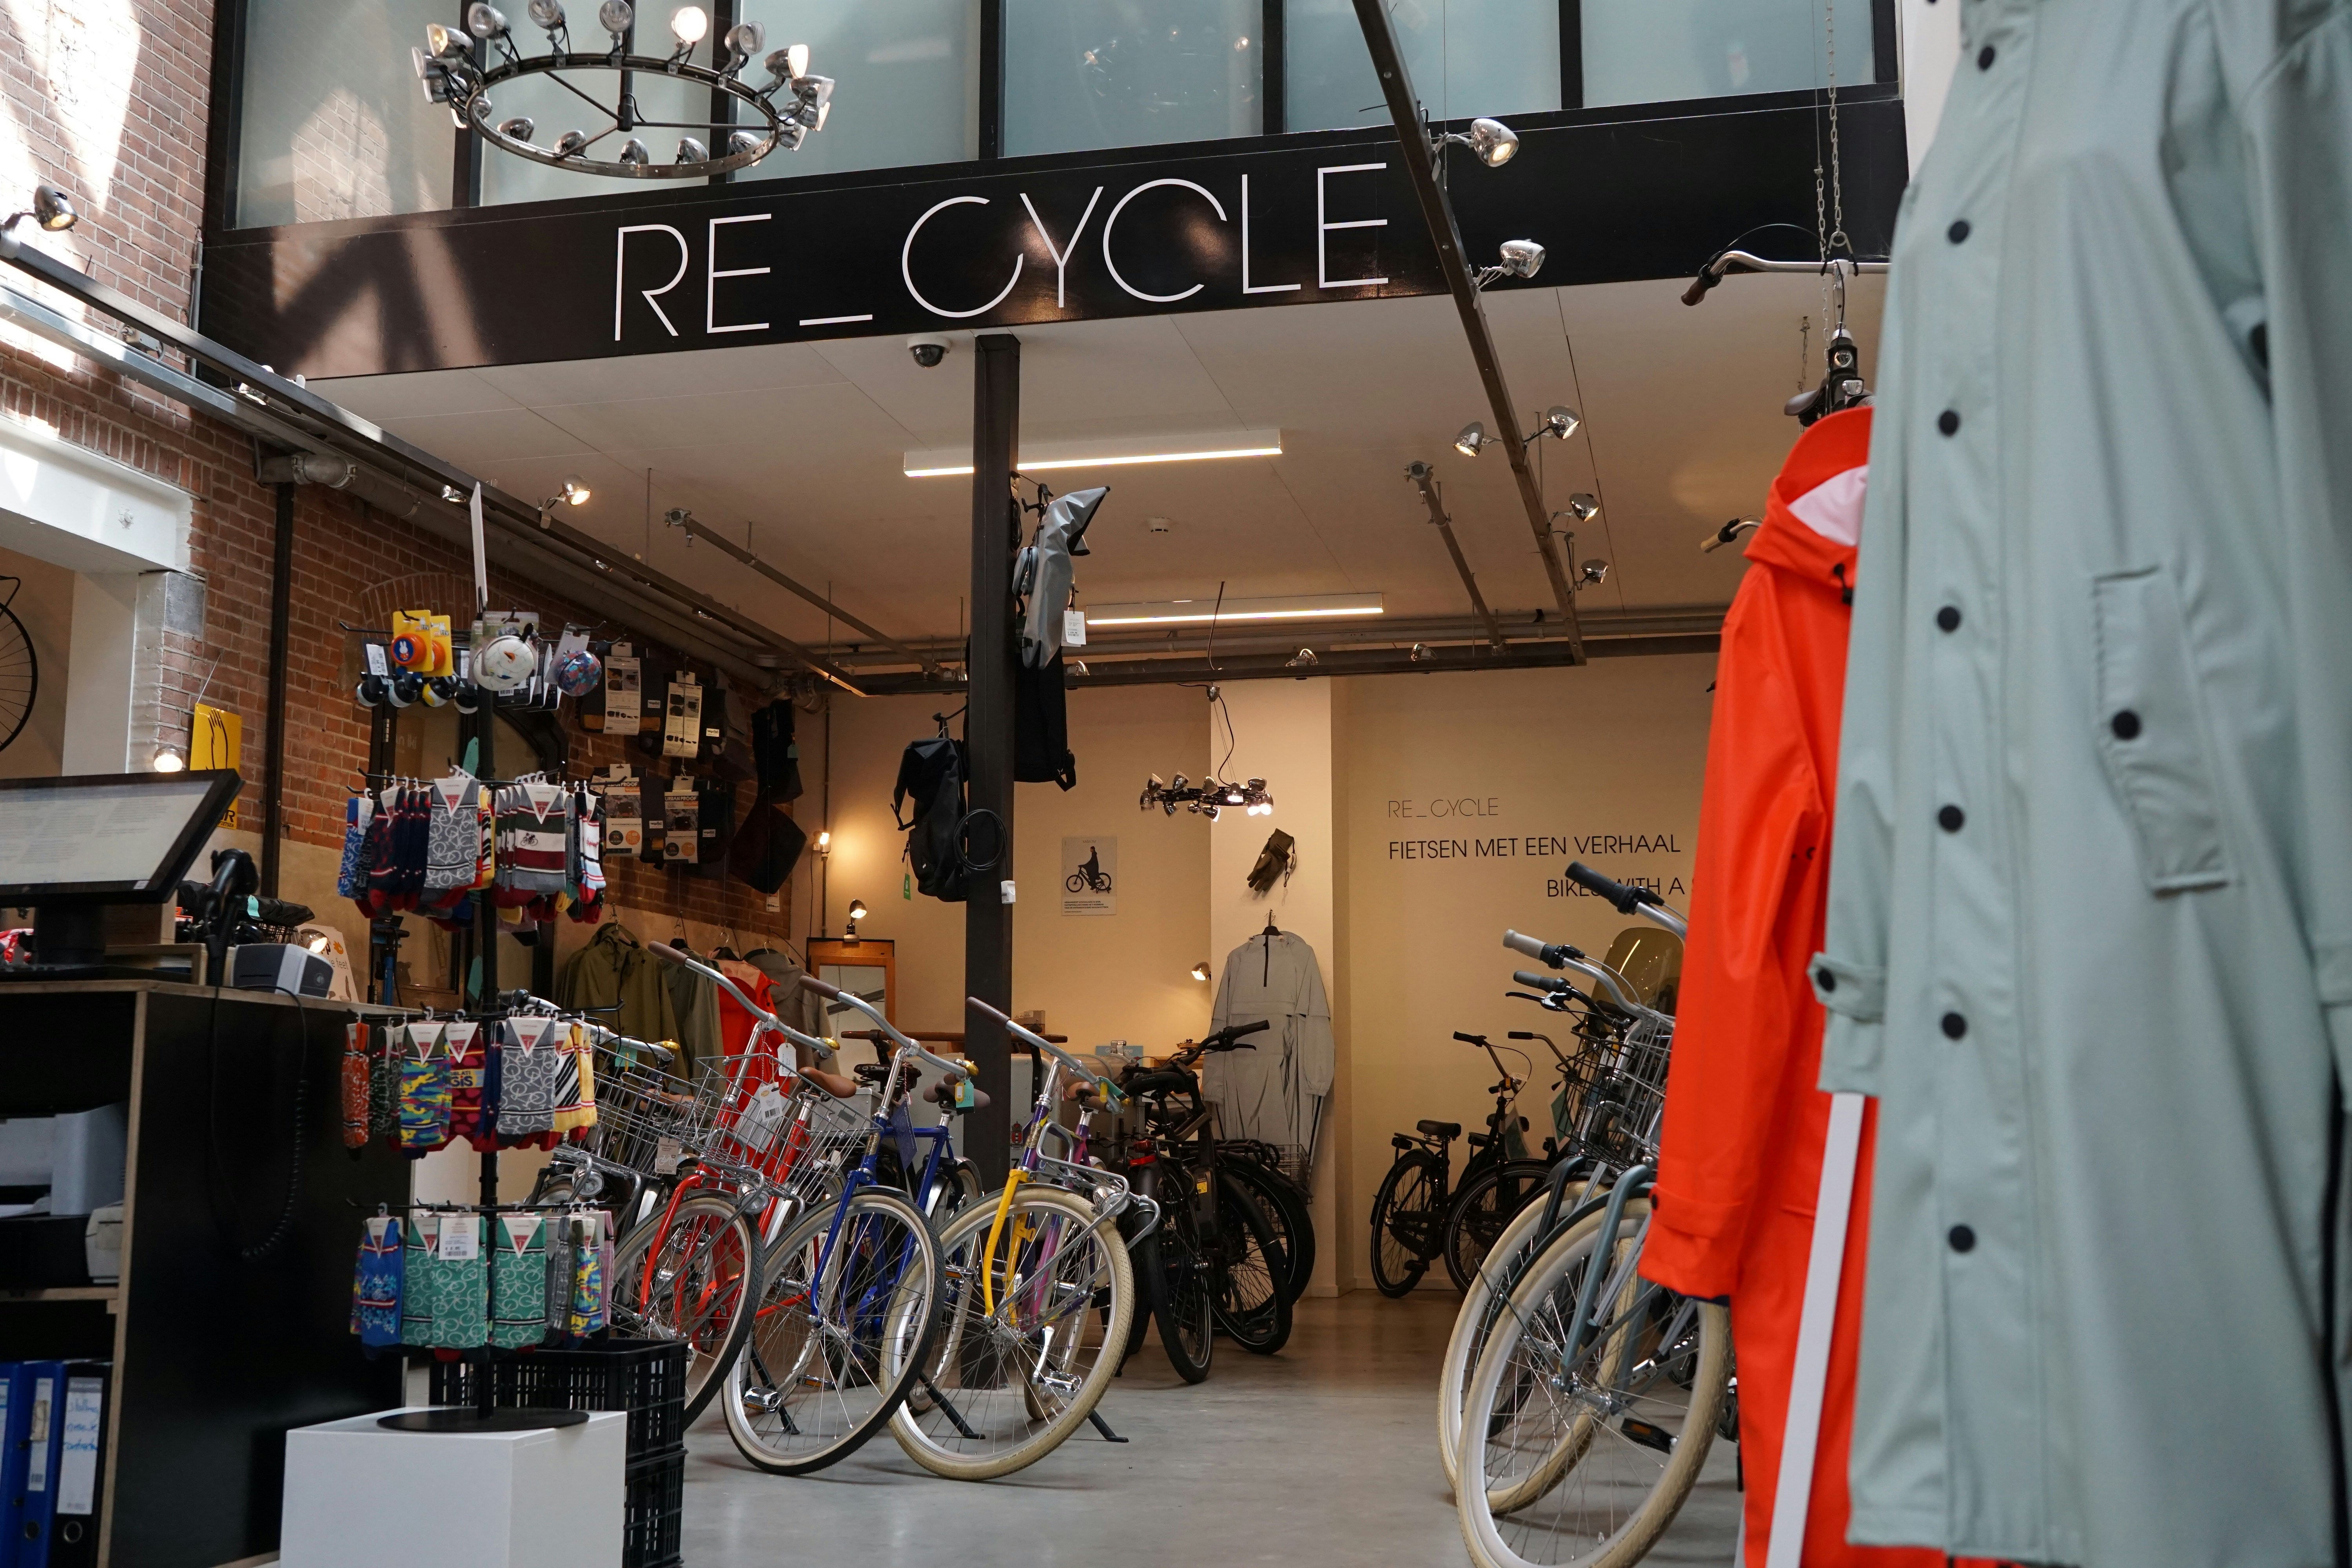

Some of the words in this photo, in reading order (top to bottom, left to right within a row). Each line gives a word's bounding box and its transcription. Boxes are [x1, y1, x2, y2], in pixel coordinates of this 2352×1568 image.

[614, 162, 1389, 341] RE_CYCLE
[1388, 797, 1499, 818] RE_CYCLE
[1389, 839, 1467, 860] FIETSEN
[1475, 838, 1519, 857] MET
[1526, 837, 1567, 856] EEN
[1573, 834, 1681, 855] VERHAAL
[1547, 879, 1599, 897] BIKE
[1668, 877, 1686, 895] A
[336, 958, 348, 969] feet
